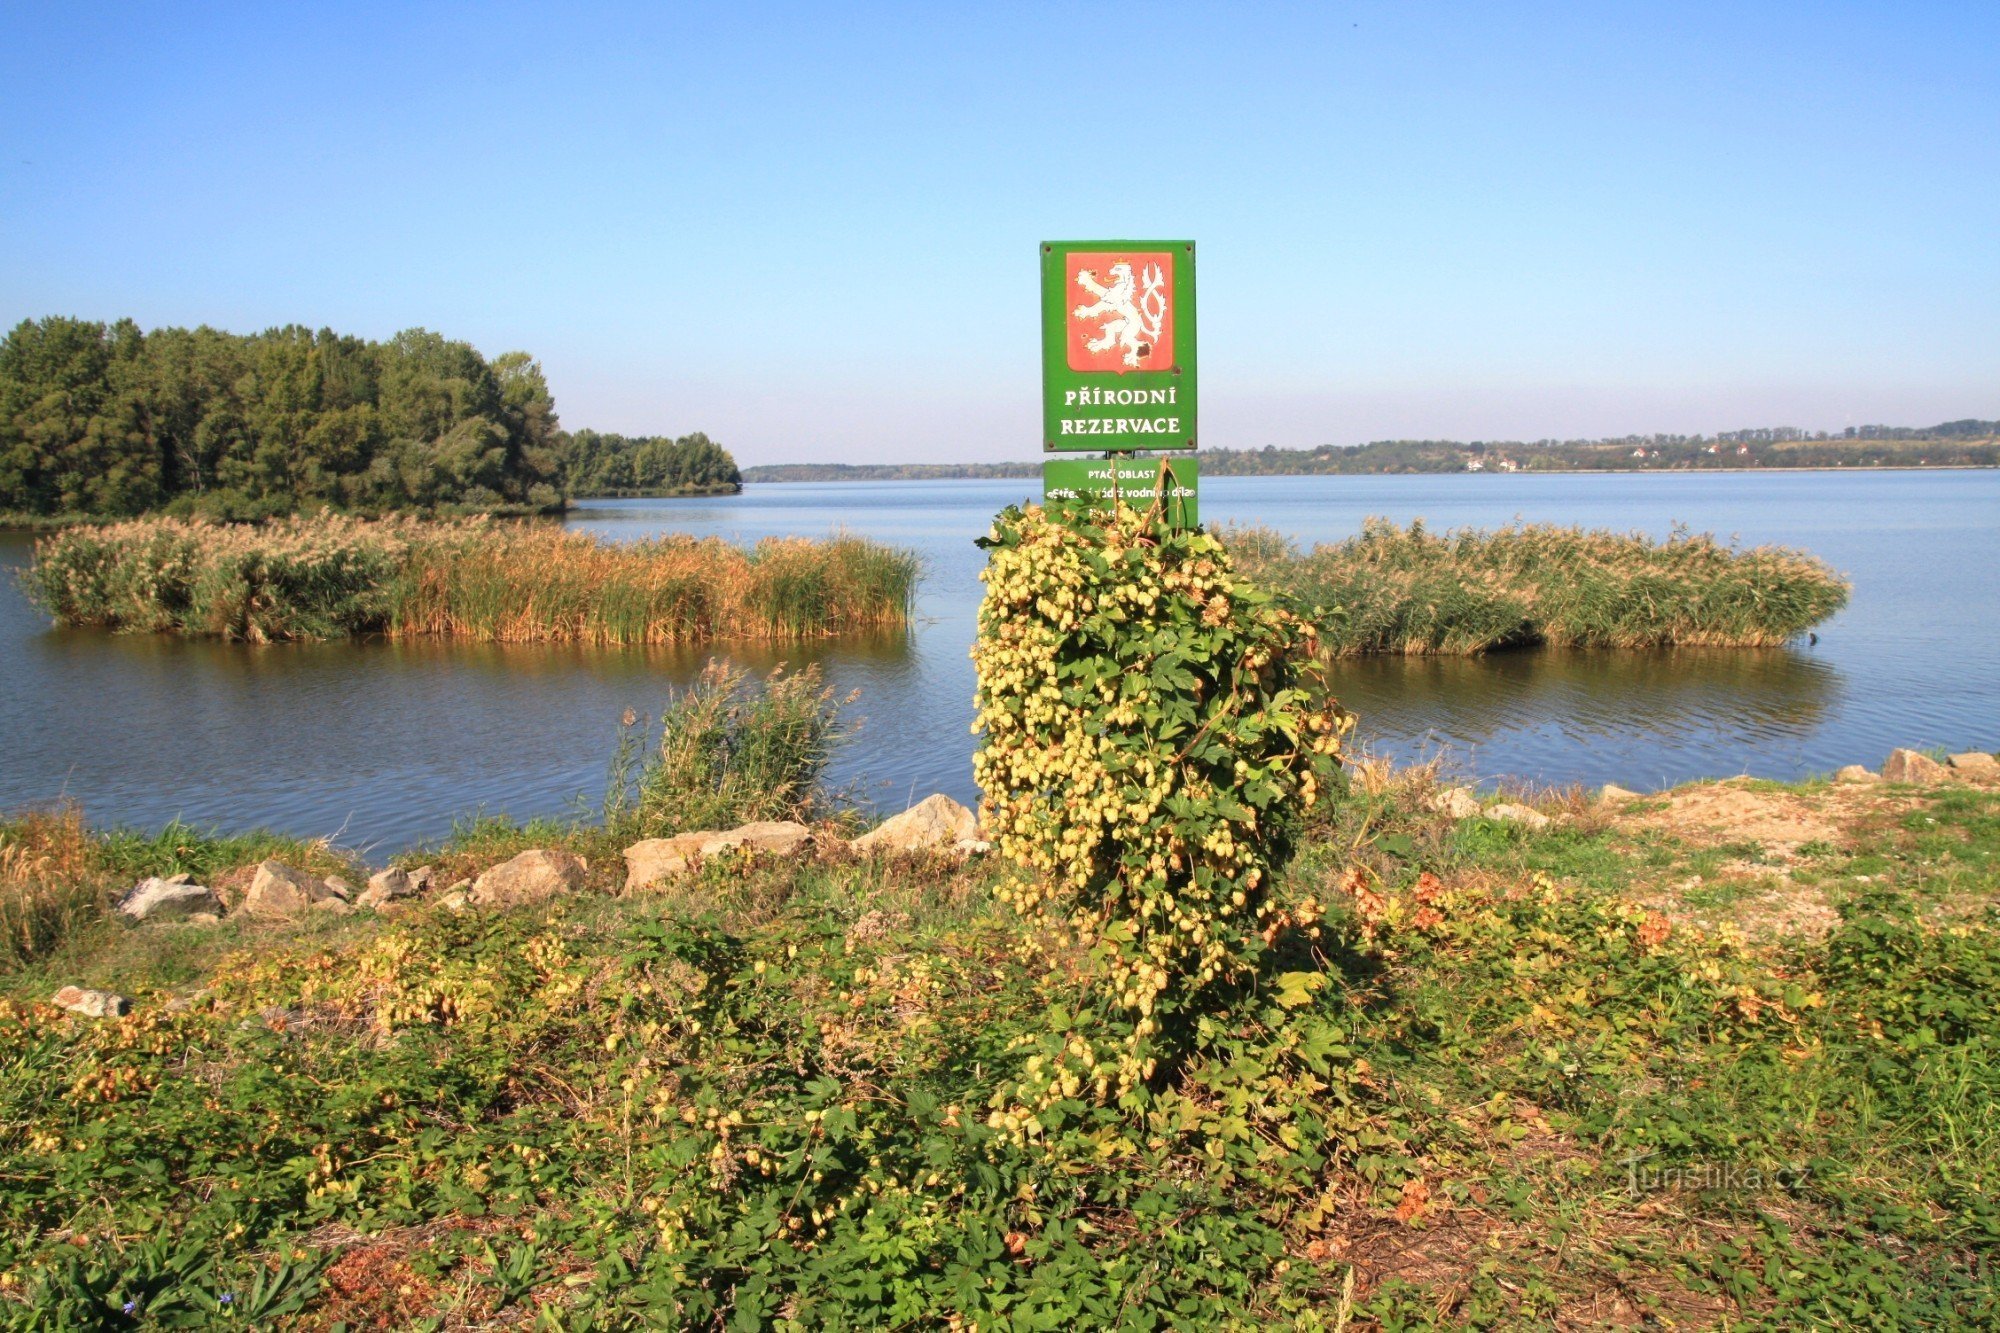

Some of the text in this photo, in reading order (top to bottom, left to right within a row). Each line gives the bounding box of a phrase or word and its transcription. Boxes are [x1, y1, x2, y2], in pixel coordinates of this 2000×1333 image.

[1065, 386, 1176, 405] PŘÍRODNÍ
[1061, 418, 1180, 434] REZERVACE
[1118, 470, 1155, 479] OBLAST
[1127, 487, 1169, 498] vodnío
